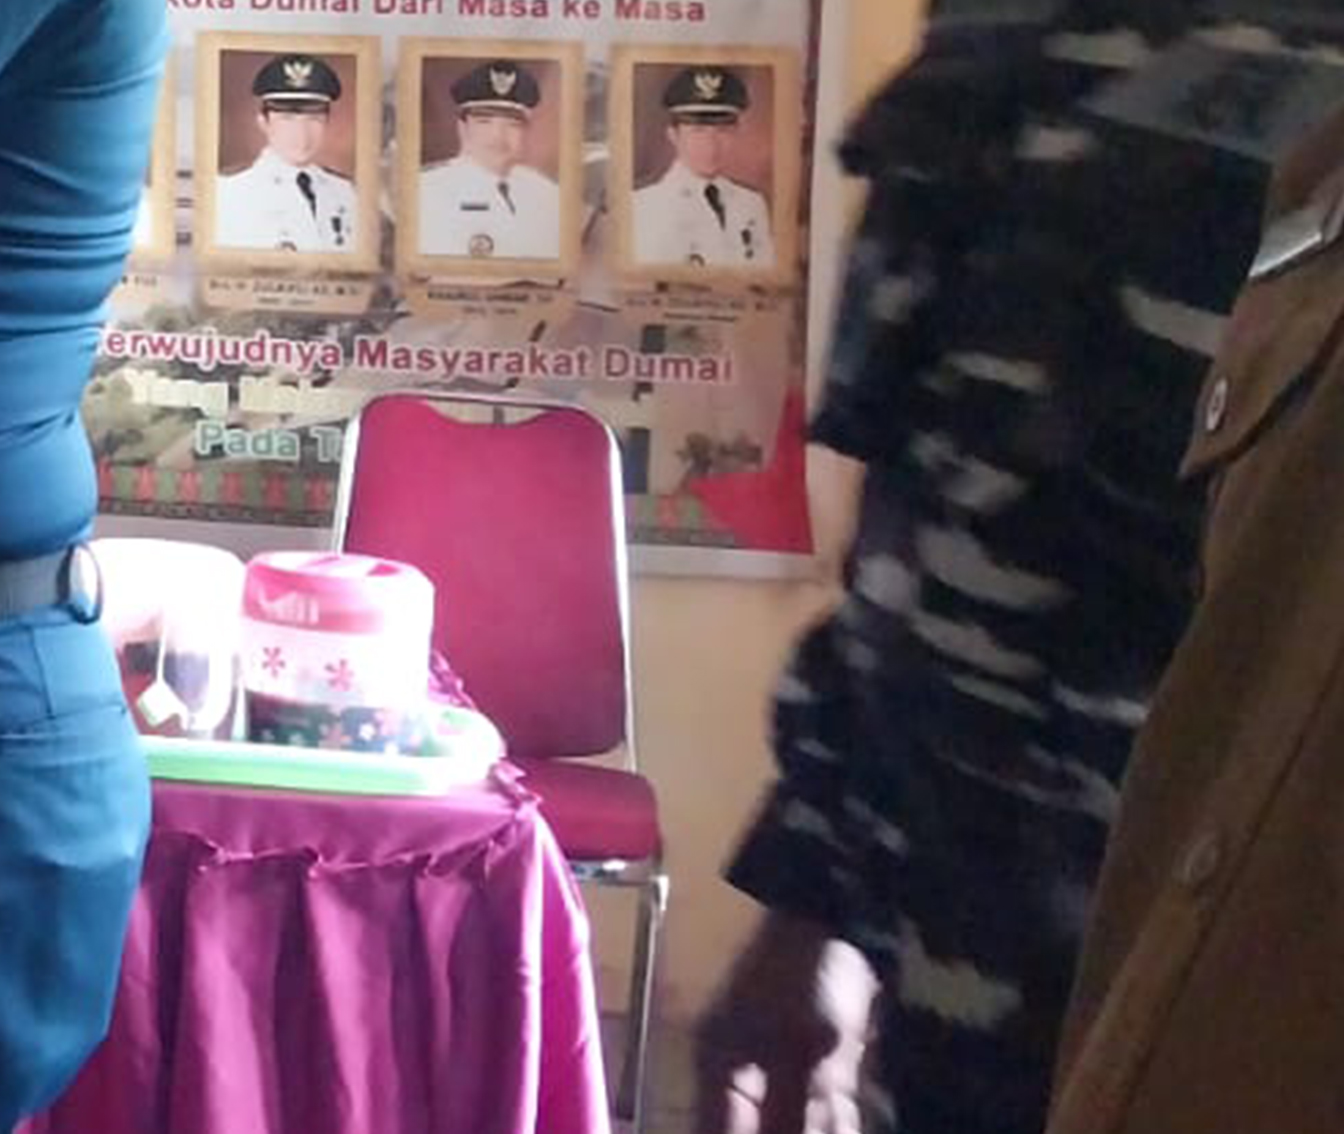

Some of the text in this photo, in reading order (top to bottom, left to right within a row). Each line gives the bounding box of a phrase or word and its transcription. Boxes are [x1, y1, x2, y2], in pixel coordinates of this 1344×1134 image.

[100, 328, 733, 382] erwujudnya Masyarakat Dumai
[196, 421, 300, 458] Pada
